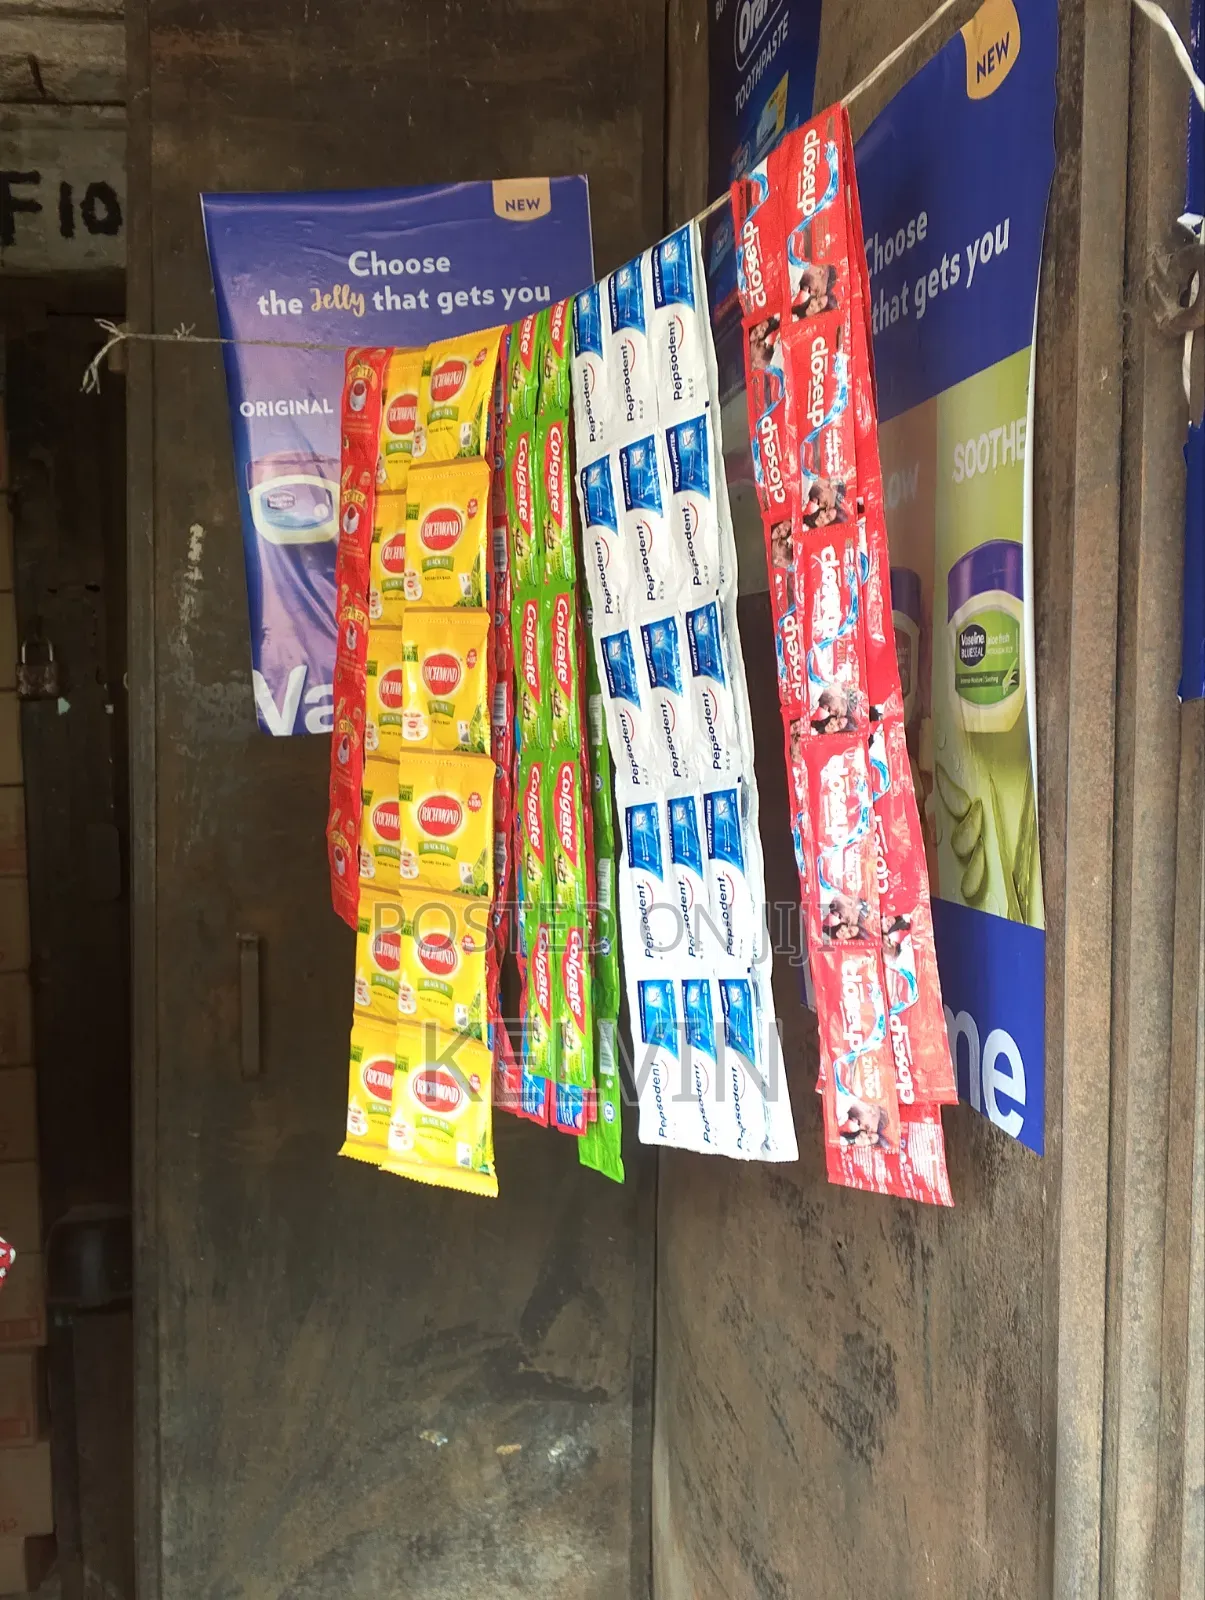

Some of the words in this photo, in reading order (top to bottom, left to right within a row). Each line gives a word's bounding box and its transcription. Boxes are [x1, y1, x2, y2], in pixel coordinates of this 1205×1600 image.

[735, 10, 789, 117] TOOTHPASTE
[975, 31, 1012, 84] NEW
[504, 197, 541, 213] NEW
[798, 129, 821, 216] closeup
[257, 289, 303, 316] the
[310, 284, 366, 318] Jelly
[373, 285, 429, 311] that
[437, 286, 495, 315] gets
[501, 285, 551, 311] you
[348, 250, 451, 277] Choose
[743, 221, 767, 307] closeup
[871, 280, 909, 336] that
[914, 252, 960, 320] gets
[966, 216, 1010, 289] you
[620, 344, 635, 422] Pepsodent
[667, 320, 683, 401] Pepsodent
[807, 336, 829, 428] closeup
[239, 398, 334, 418] ORIGINAL
[582, 366, 597, 443] Pepsodent
[516, 437, 529, 522] Colgate
[550, 426, 562, 515] Colgate
[669, 431, 679, 462] FIGHTER
[672, 464, 680, 488] CAVITY
[761, 416, 786, 504] closeup
[953, 415, 1027, 484] SOOTHE
[424, 520, 459, 538] RICHMOND
[635, 525, 656, 601] Pepsodent
[682, 506, 702, 586] Pepsodent
[595, 541, 614, 614] Pepsodent
[523, 603, 538, 687] Colgate
[555, 598, 569, 684] Colgate
[687, 617, 695, 646] FIGHTER
[690, 647, 699, 671] CAVITY
[961, 631, 985, 646] Vaseline
[619, 713, 641, 785] Pepsodent
[660, 702, 682, 777] Pepsodent
[702, 692, 722, 770] Pepsodent
[421, 806, 459, 825] RICHMOND
[527, 766, 541, 849] Colgate
[559, 765, 573, 850] Colgate
[637, 884, 654, 959] Pepsodent
[678, 880, 697, 957] Pepsodent
[716, 876, 735, 957] Pepsodent
[535, 926, 550, 1012] Colgate
[566, 930, 583, 1016] Colgate
[841, 959, 863, 1052] closeup
[650, 1062, 668, 1138] Pepsodent
[693, 1064, 711, 1143] Pepsodent
